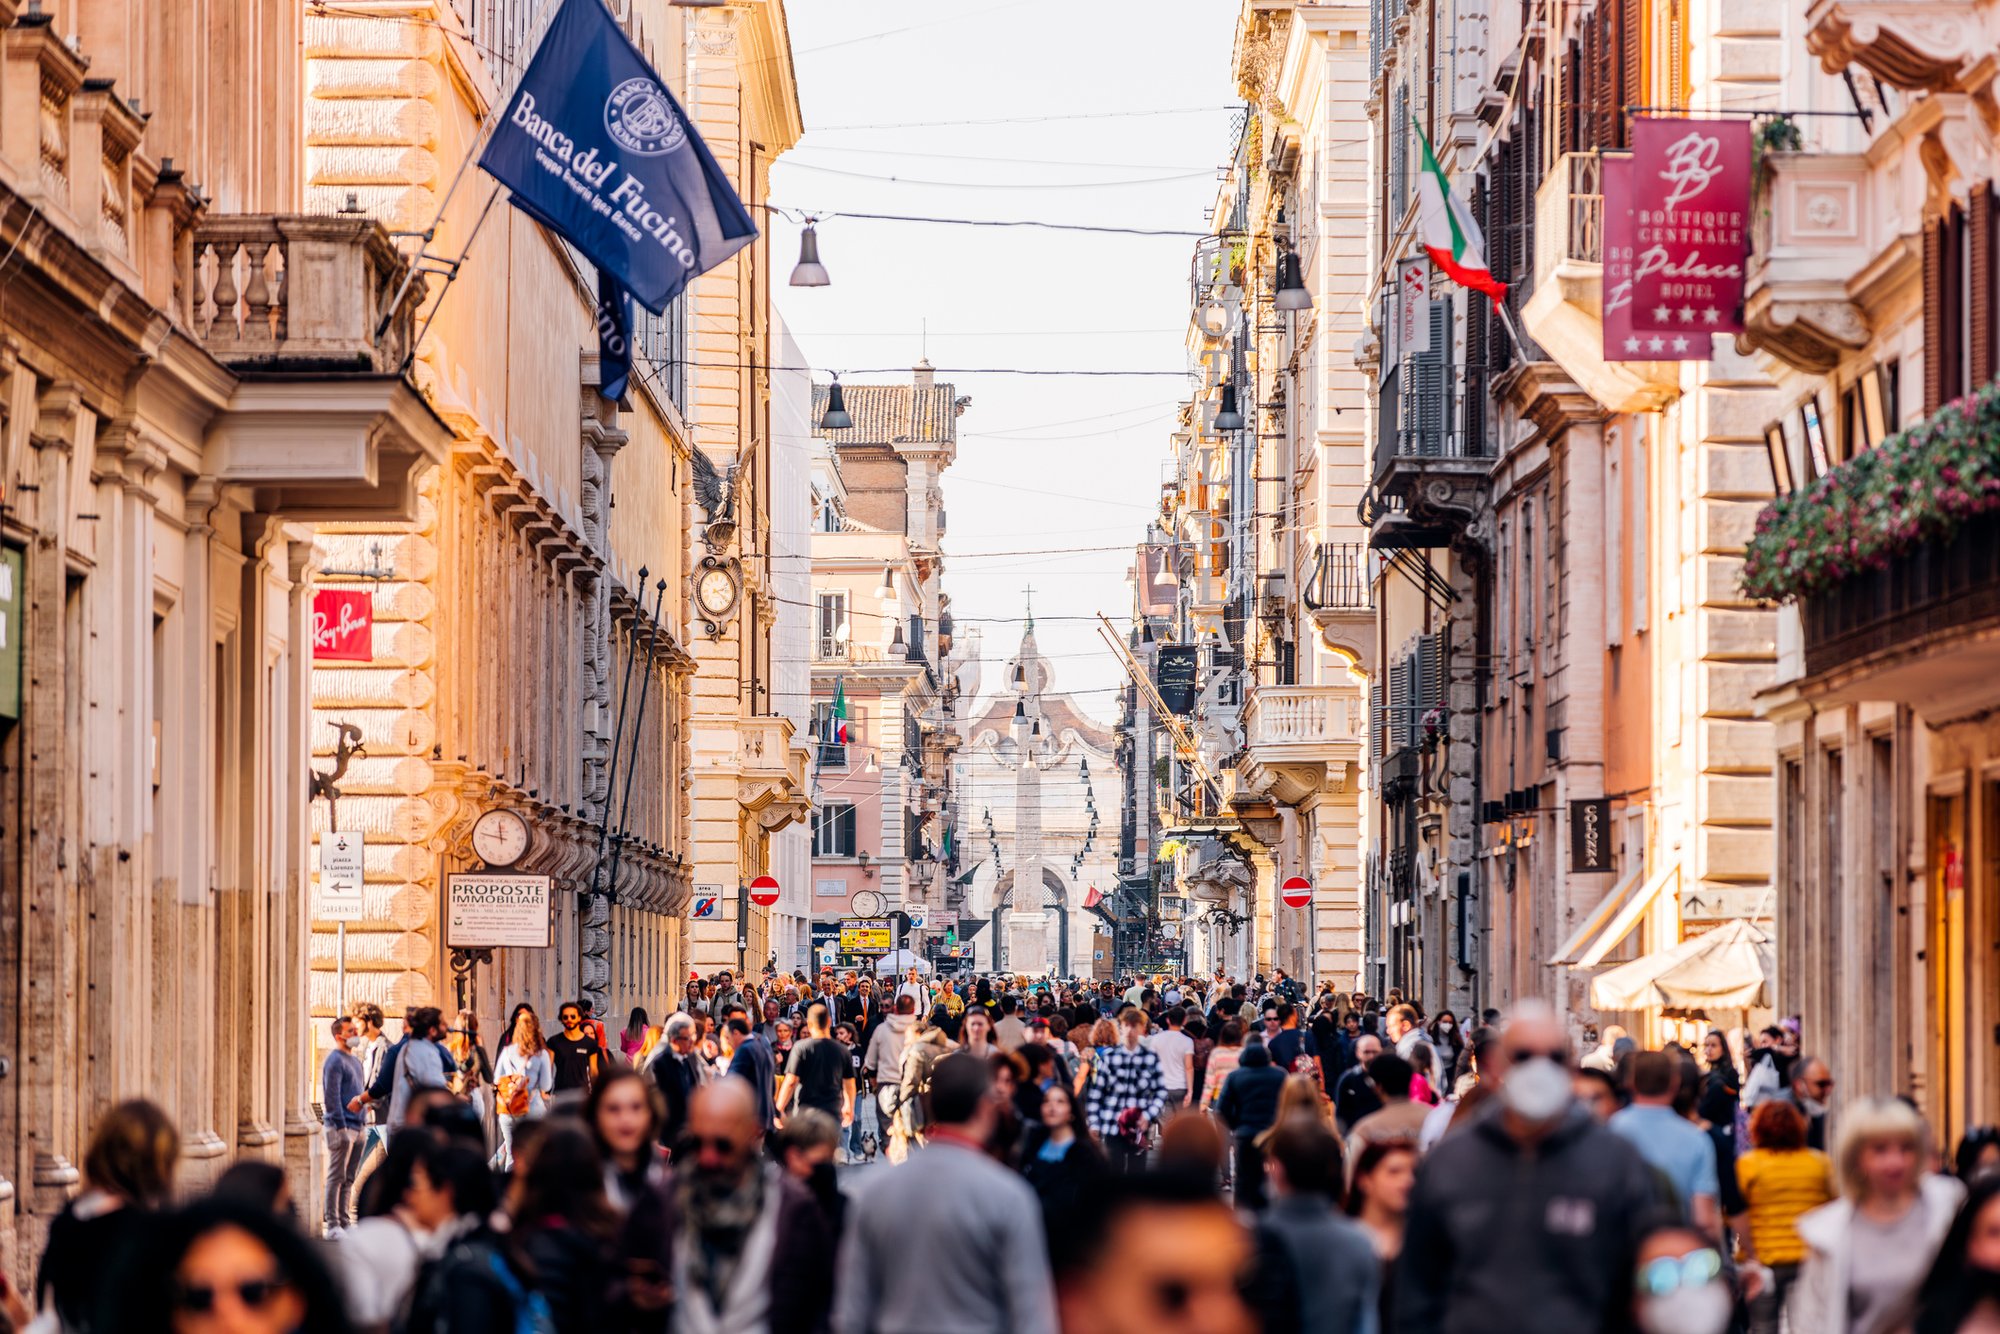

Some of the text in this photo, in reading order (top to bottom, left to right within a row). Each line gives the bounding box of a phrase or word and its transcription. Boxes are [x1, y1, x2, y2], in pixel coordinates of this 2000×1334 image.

[612, 81, 654, 107] BANCA
[610, 120, 642, 150] ROMA
[511, 90, 696, 269] Banca del Fucino
[535, 147, 564, 177] Gruppo
[591, 194, 613, 218] Igea
[610, 210, 643, 243] Banca
[1637, 209, 1742, 228] BOUTIQUE
[1637, 228, 1742, 245] CENTRALE
[1634, 243, 1743, 283] Palace
[1659, 282, 1715, 298] HOTEL
[1195, 246, 1236, 752] HOTEL PLAZA
[1583, 804, 1599, 867] COLONNA
[452, 884, 544, 896] PROPOSTE
[452, 895, 544, 904] IMMOBILIARI
[851, 1055, 861, 1068] B
